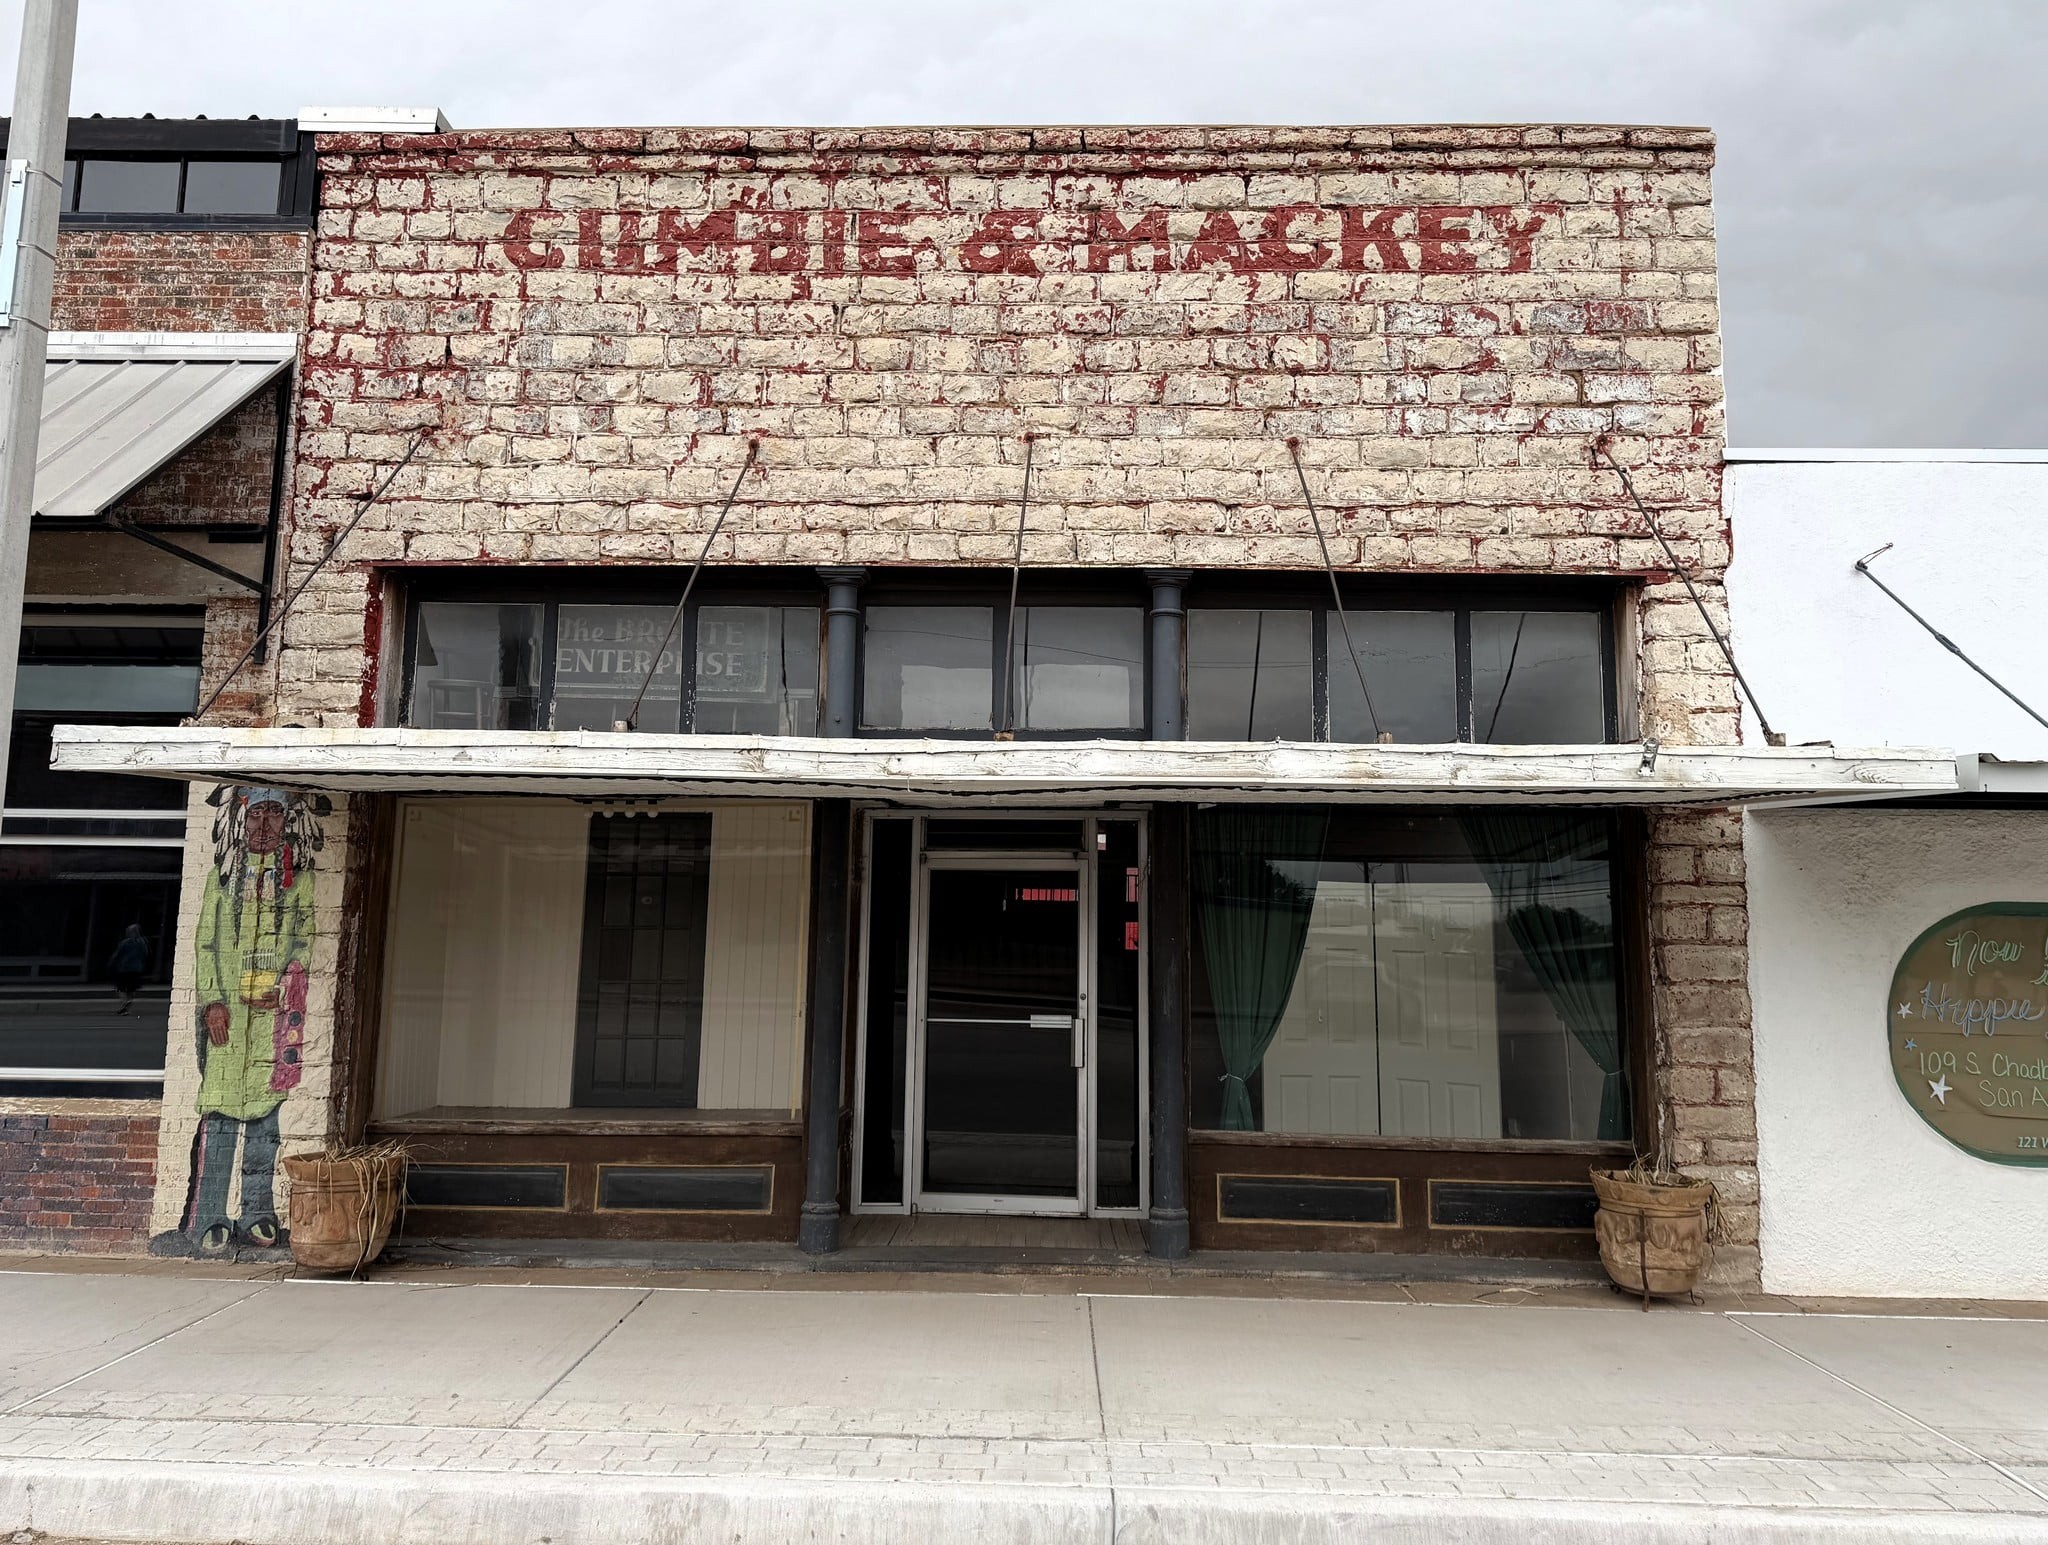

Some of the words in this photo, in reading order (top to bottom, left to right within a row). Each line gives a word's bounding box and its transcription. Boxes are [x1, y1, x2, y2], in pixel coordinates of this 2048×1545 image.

[1088, 206, 1546, 273] MACKEY
[560, 616, 605, 642] The
[615, 617, 745, 646] BROTE
[557, 648, 745, 677] ENTERPISE
[1945, 930, 2025, 977] Now
[1920, 1052, 1957, 1075] 109
[1979, 1079, 2023, 1108] San
[2018, 1136, 2038, 1149] 121
